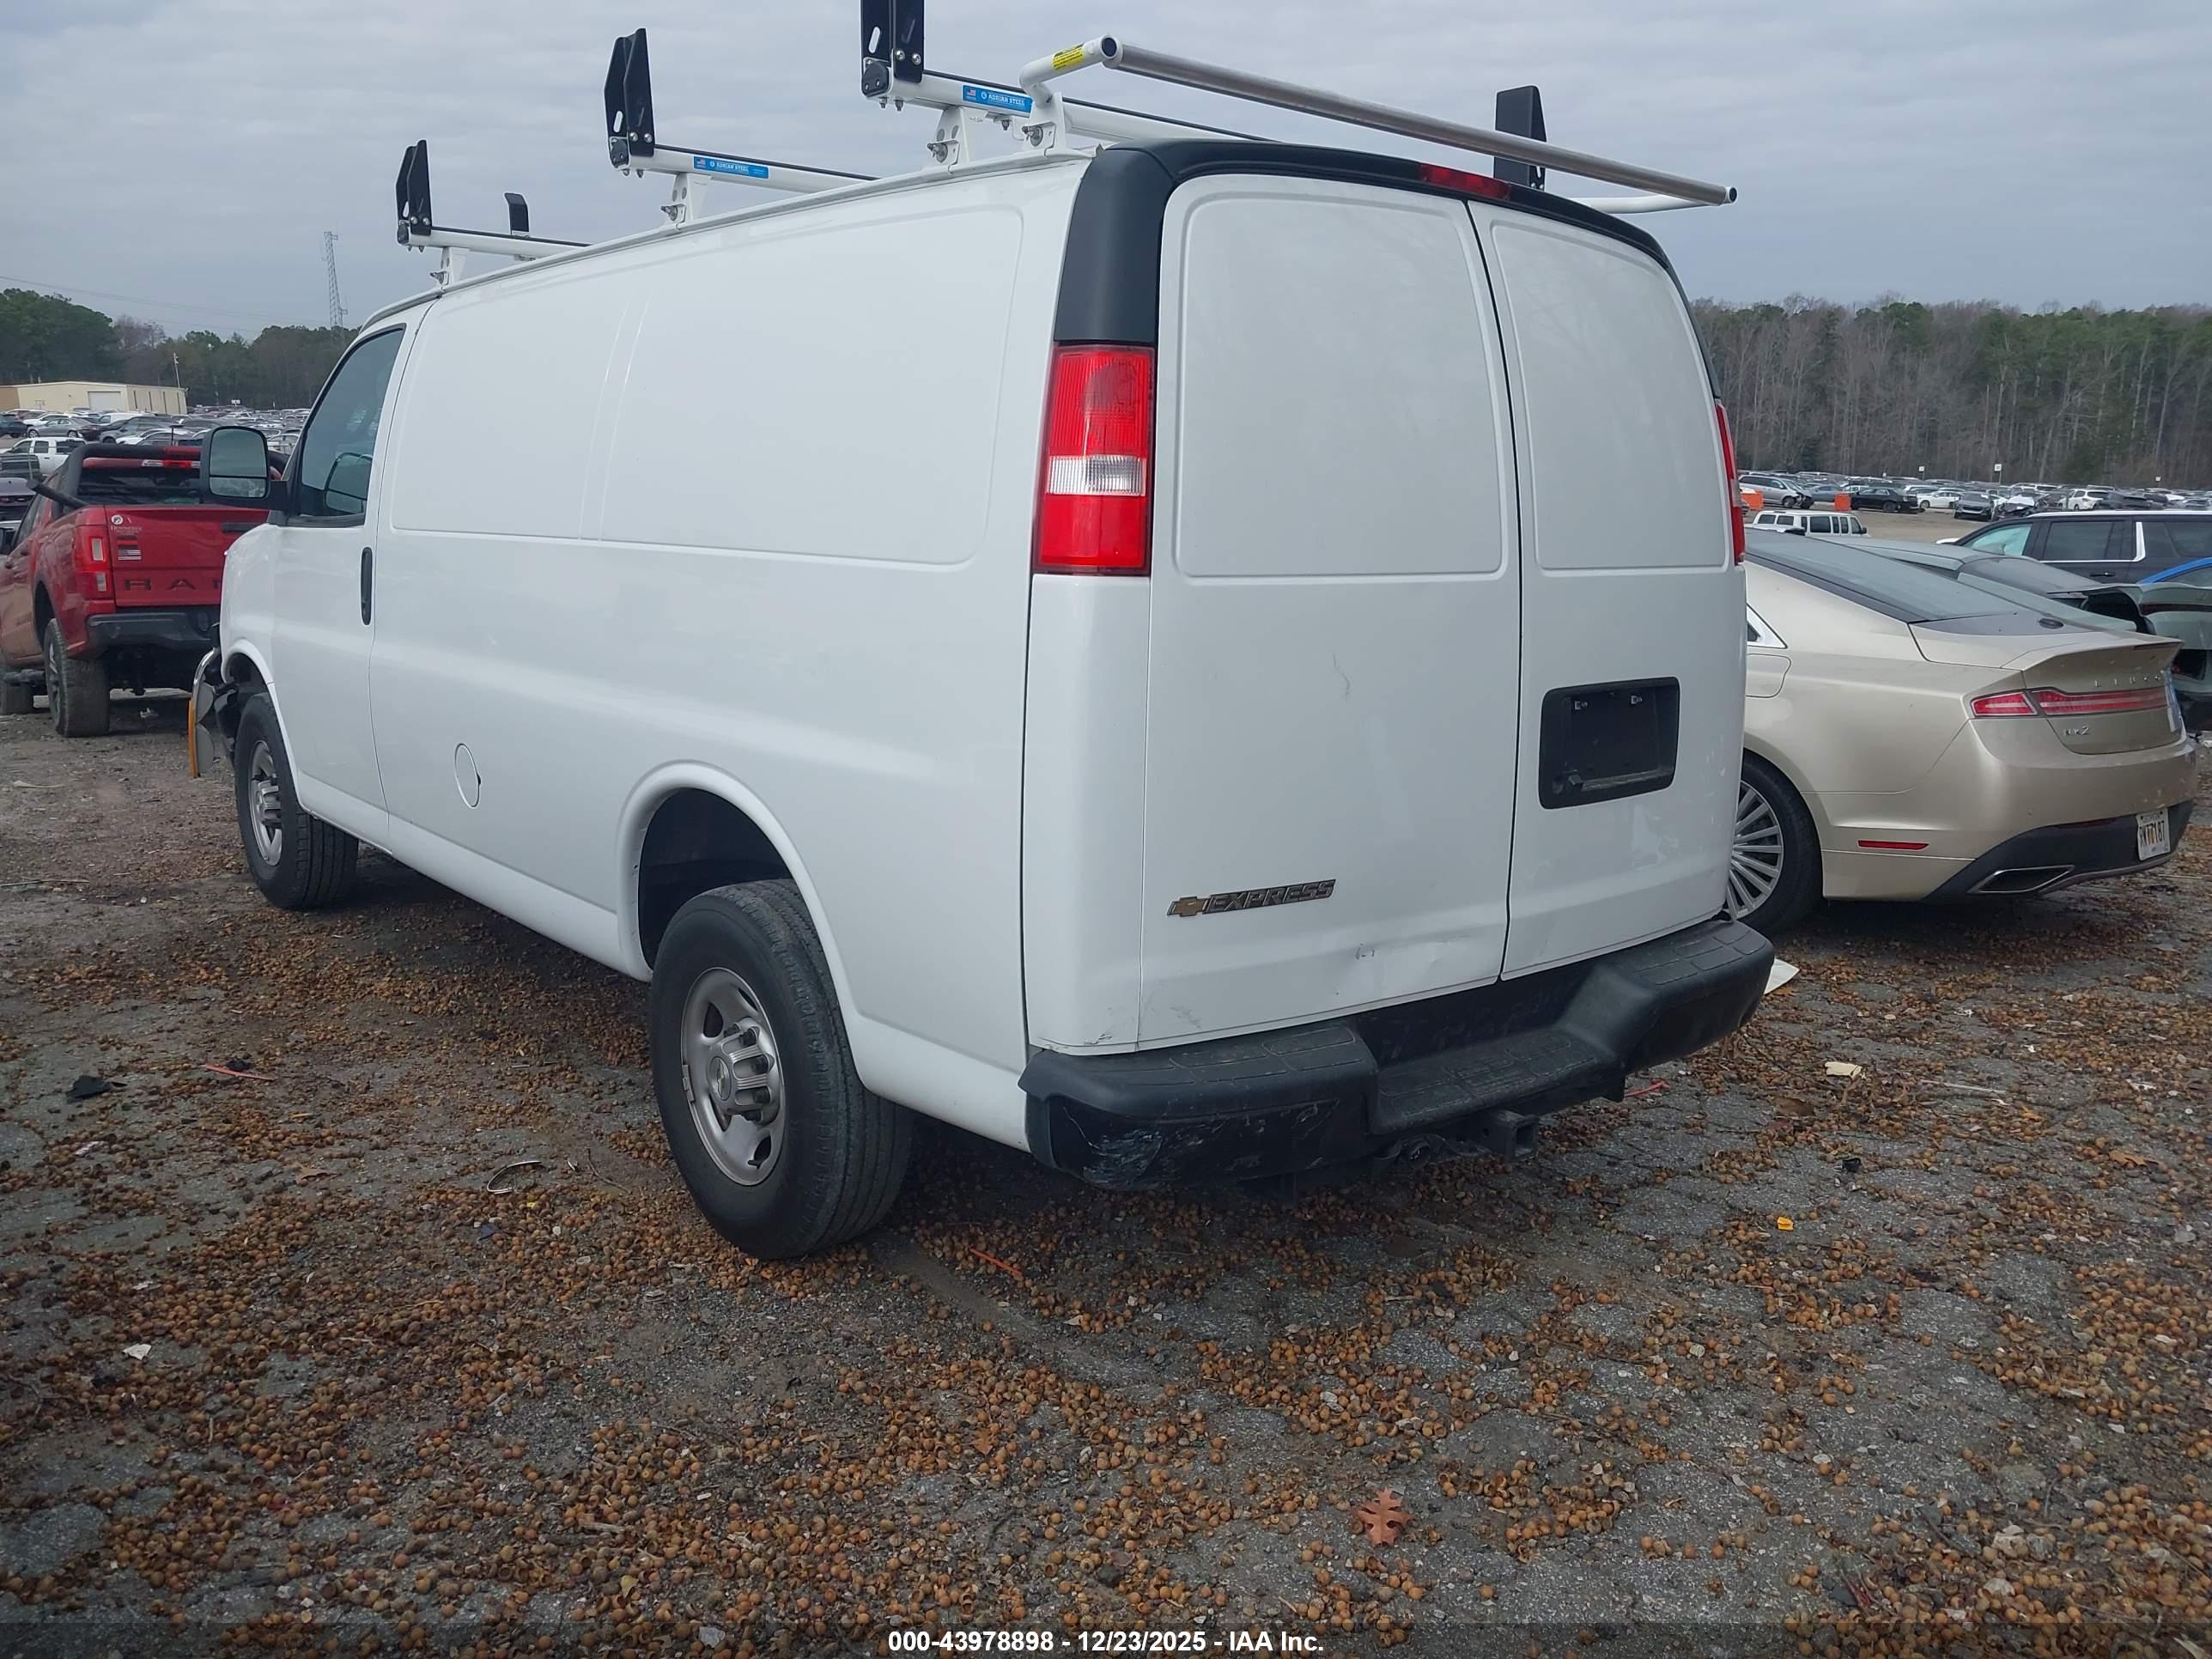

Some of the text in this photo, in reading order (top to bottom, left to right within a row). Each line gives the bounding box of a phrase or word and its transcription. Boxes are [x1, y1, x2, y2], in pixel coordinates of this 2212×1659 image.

[988, 94, 1009, 103] ADRIAN
[1009, 98, 1025, 106] STEEL
[1202, 879, 1336, 915] EXPRESS
